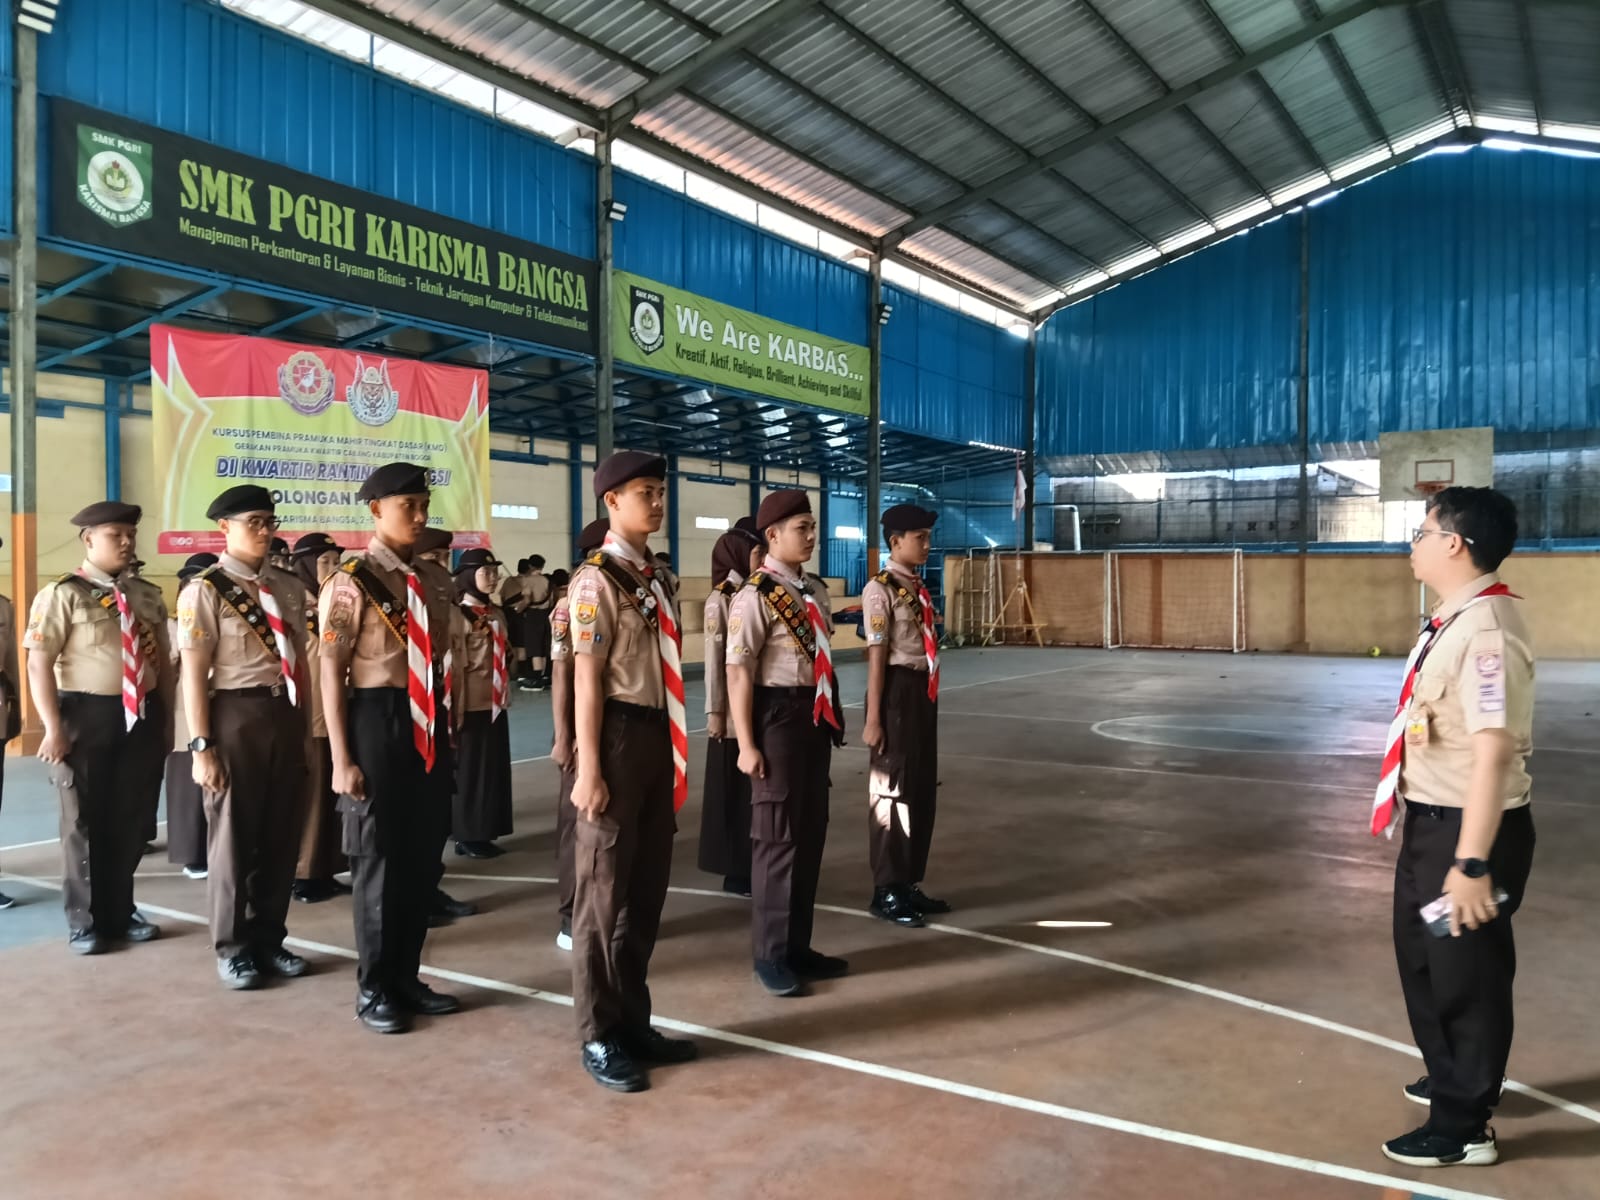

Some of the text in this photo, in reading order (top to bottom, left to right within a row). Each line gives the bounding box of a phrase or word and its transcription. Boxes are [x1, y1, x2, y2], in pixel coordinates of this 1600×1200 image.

[91, 132, 142, 154] SMK PGRI
[78, 183, 152, 223] KARISMA BANGSA
[178, 158, 589, 312] SMK PGRI KARISMA BANGSA
[179, 216, 249, 250] Manajemen
[251, 234, 321, 267] Perkantoran
[323, 253, 332, 270] &
[334, 255, 375, 278] Layanan
[377, 266, 407, 288] Bisnis
[416, 276, 444, 297] Teknik
[446, 285, 484, 308] Jaringan
[485, 293, 524, 317] Komputer
[526, 304, 533, 318] &
[534, 305, 589, 331] Telekomunikasi
[676, 304, 714, 342] We
[722, 320, 761, 355] Are
[768, 332, 863, 382] KARBAS...
[676, 342, 708, 366] Kreatif,
[710, 351, 731, 371] Aktif,
[733, 356, 765, 379] Religius,
[234, 442, 271, 452] GERAKAN
[272, 445, 309, 455] PRAMUKA
[293, 433, 334, 444] PRAMUKA
[336, 436, 363, 447] MAHIR
[363, 438, 398, 449] TINGKAT
[216, 457, 239, 477] DI
[240, 457, 316, 480] KWARTIR
[271, 489, 351, 505] OLONGAN
